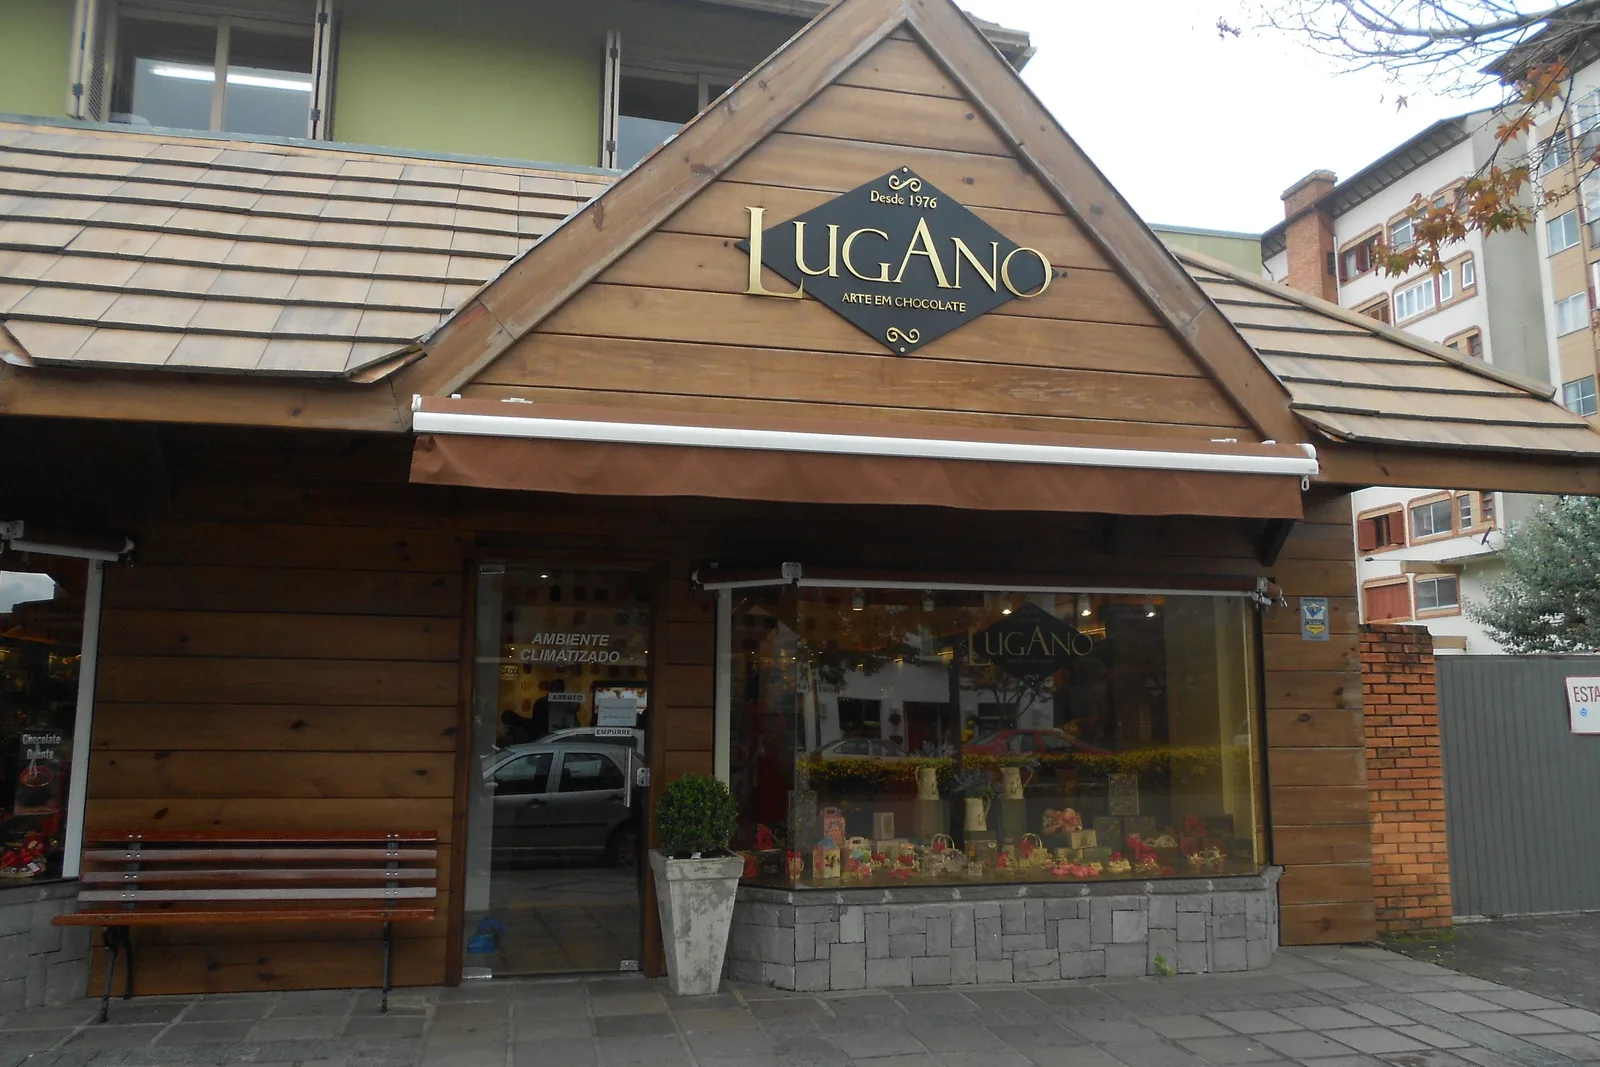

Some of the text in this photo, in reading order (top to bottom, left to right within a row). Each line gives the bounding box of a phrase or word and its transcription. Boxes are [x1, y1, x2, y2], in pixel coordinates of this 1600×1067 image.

[870, 190, 938, 210] Desde 1976
[743, 206, 1053, 299] LUGANO
[842, 293, 966, 313] ARTE EM CHOCOLATE
[532, 632, 610, 647] AMBIENTE
[967, 624, 1094, 667] LUGANO
[520, 648, 620, 663] CLIMATIZADO
[500, 666, 520, 676] CAIXA
[22, 733, 61, 745] Chocolate
[596, 728, 632, 736] EMPURRE
